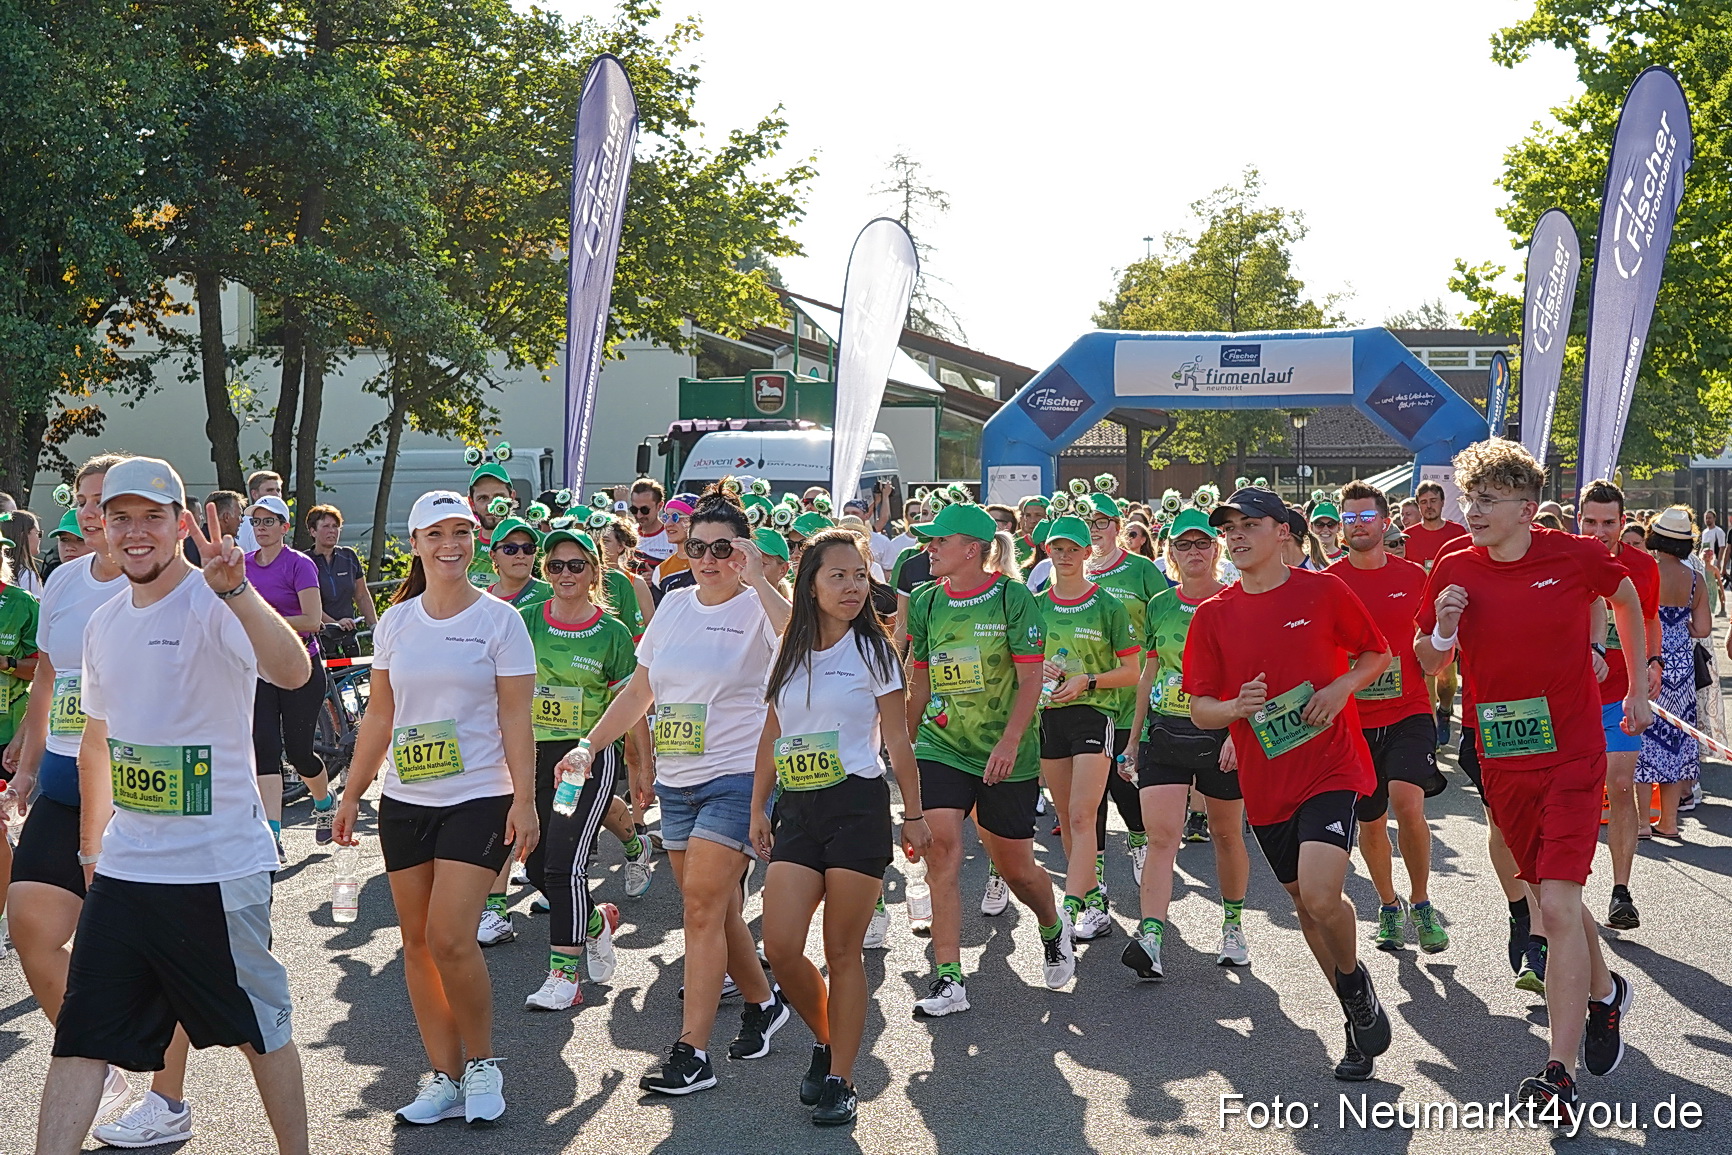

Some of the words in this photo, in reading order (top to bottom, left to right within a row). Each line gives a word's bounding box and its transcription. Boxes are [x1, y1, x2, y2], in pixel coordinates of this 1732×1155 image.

[590, 94, 620, 232] Fischer
[1626, 110, 1671, 252] Fischer
[1645, 133, 1677, 248] AUTOMOBILE
[1540, 236, 1565, 335] Fischer
[1553, 250, 1570, 330] AUTOMOBILE
[1227, 351, 1259, 360] Fischer
[1206, 367, 1295, 384] firmenlauf
[1036, 395, 1084, 407] Fischer
[1381, 396, 1394, 404] und
[694, 458, 733, 467] abavent
[433, 498, 454, 506] PUMA
[948, 586, 1001, 608] MONSTERSTARK
[1053, 598, 1097, 614] MONSTERSTARK
[547, 619, 604, 639] MONSTERSTARK
[930, 668, 938, 691] WALK
[943, 664, 961, 681] 51
[973, 664, 982, 686] 2022
[542, 699, 561, 717] 93
[535, 713, 553, 722] Schön
[553, 716, 568, 724] Petra
[659, 721, 693, 740] 1879
[694, 725, 702, 749] 2022
[1272, 728, 1301, 747] Schreiber
[1484, 728, 1494, 748] RUN
[1491, 718, 1541, 740] 1702
[1541, 719, 1553, 745] 2022
[1259, 730, 1274, 749] RUN
[1497, 740, 1517, 748] Ferstl
[1517, 738, 1539, 746] Moritz
[396, 749, 405, 777] WALK
[403, 741, 446, 765] 1877
[448, 743, 459, 768] 2022
[786, 751, 830, 774] 1876
[426, 760, 452, 770] Nathalie
[778, 759, 790, 785] WALK
[829, 753, 842, 777] 2022
[117, 764, 167, 793] 1896
[791, 774, 814, 782] Nguyen
[813, 771, 830, 779] Minh
[119, 788, 138, 800] Strauß
[138, 791, 164, 803] Justin
[169, 774, 178, 806] 2022
[1325, 825, 1346, 837] adidas
